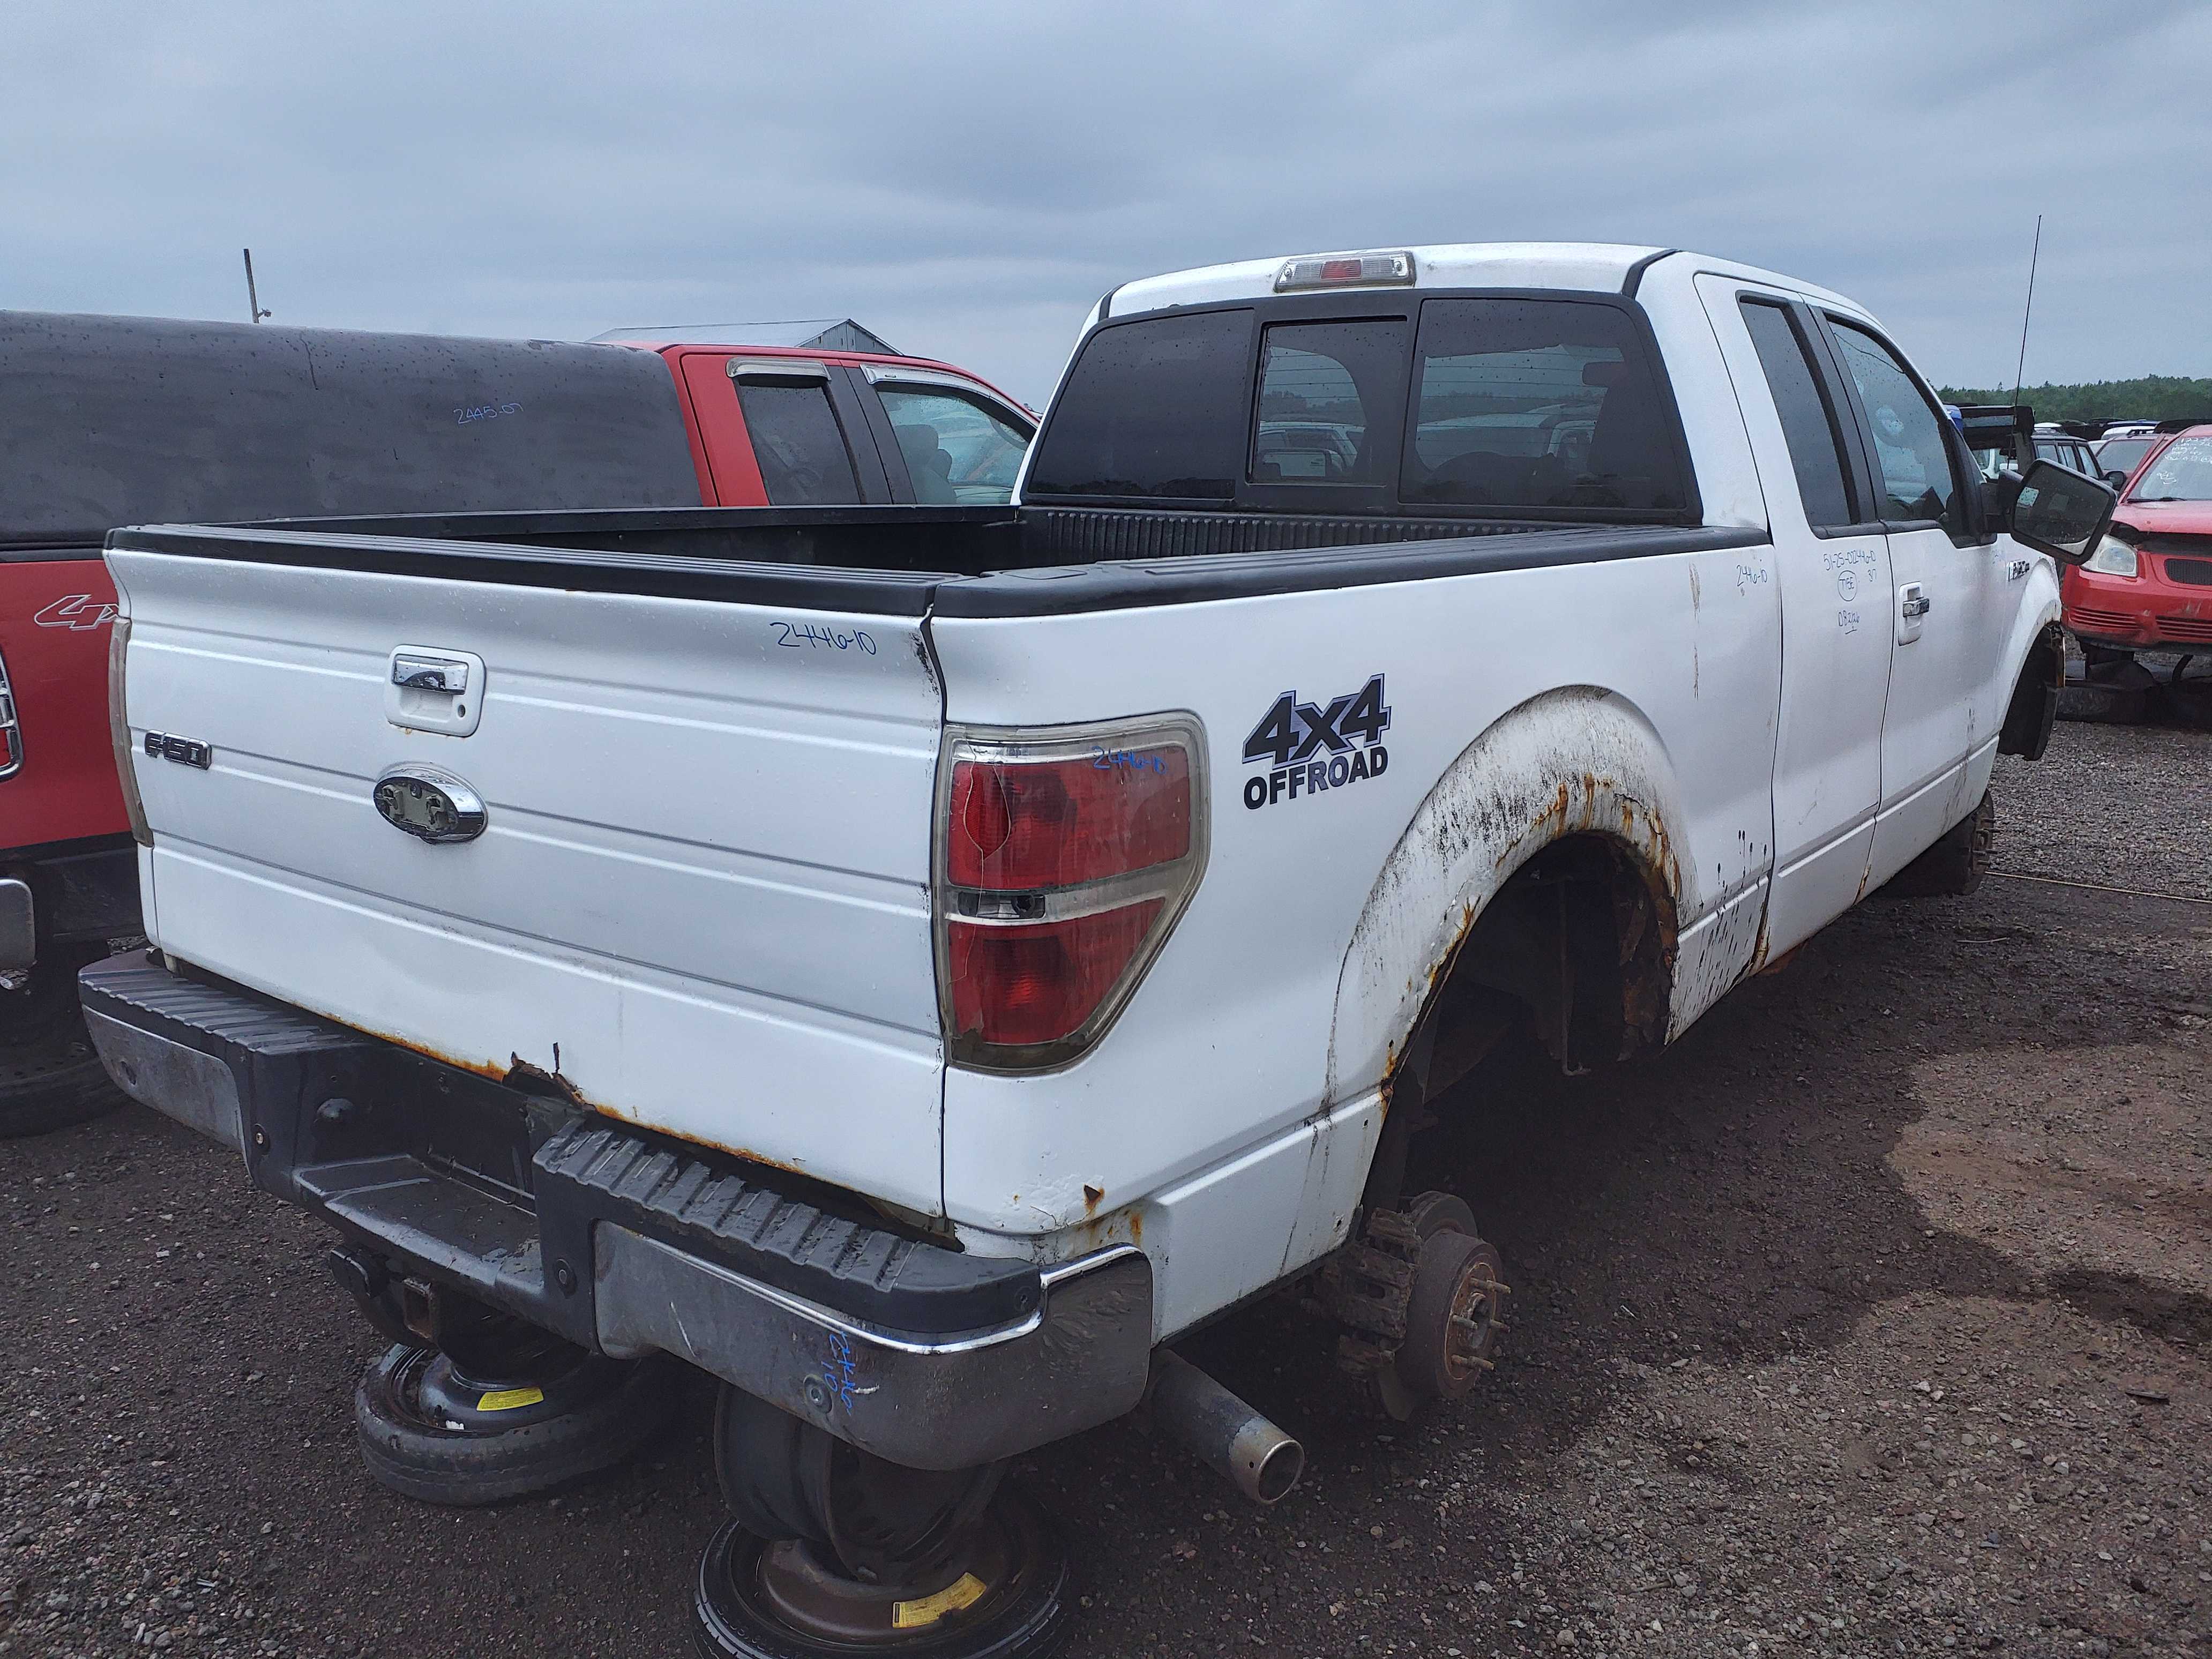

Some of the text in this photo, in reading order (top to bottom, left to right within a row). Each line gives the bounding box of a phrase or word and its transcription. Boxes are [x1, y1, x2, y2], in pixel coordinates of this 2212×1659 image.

[453, 403, 524, 424] 2445-07
[769, 622, 877, 655] 2446-10
[1242, 673, 1392, 770] 4x4
[1243, 746, 1389, 810] OFFROAD
